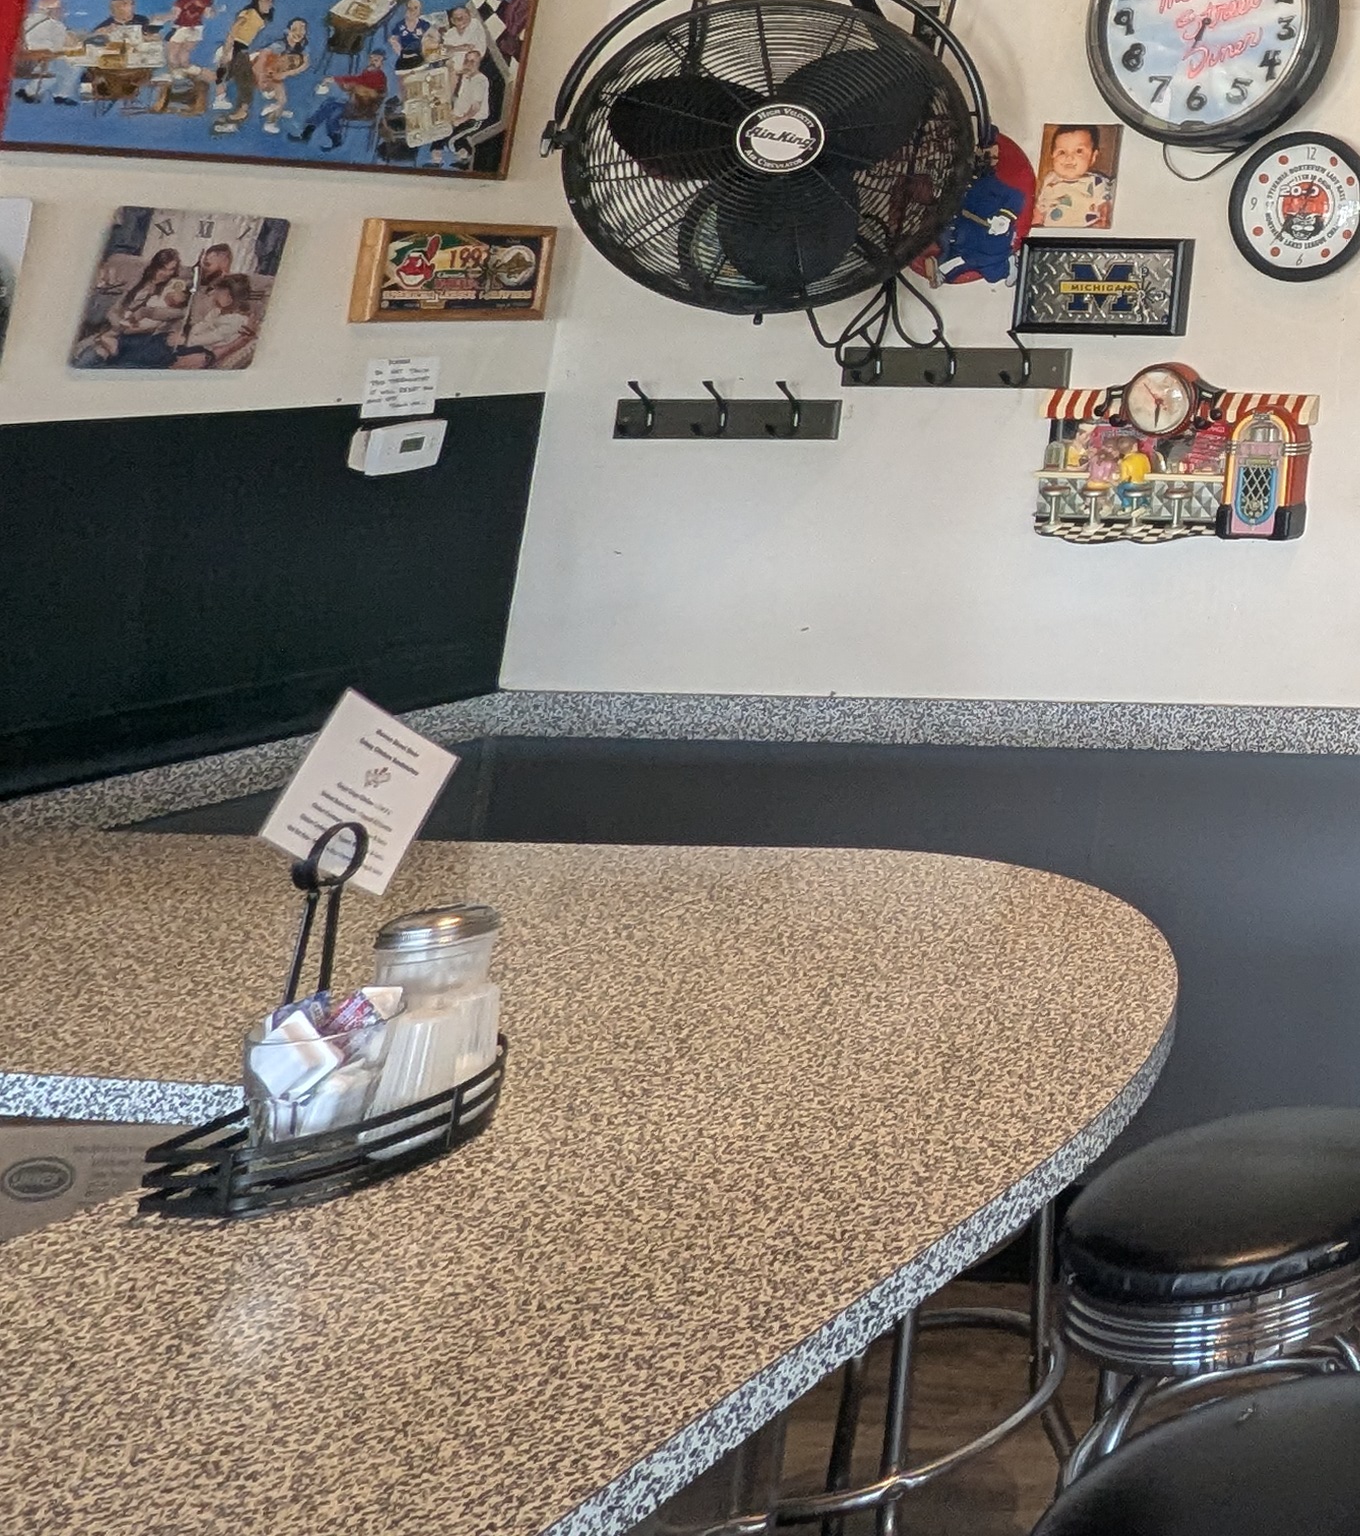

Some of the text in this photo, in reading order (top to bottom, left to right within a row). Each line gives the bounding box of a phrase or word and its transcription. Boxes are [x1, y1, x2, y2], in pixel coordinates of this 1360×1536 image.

[1114, 8, 1134, 35] 9
[1277, 16, 1296, 41] 3
[1122, 43, 1146, 72] 8
[1259, 49, 1282, 81] 4
[1149, 75, 1172, 103] 7
[1186, 85, 1207, 110] 6
[1226, 77, 1253, 104] 5
[1306, 147, 1317, 160] 12
[1250, 197, 1258, 210] 9
[450, 246, 489, 268] 199
[1296, 253, 1303, 265] 6
